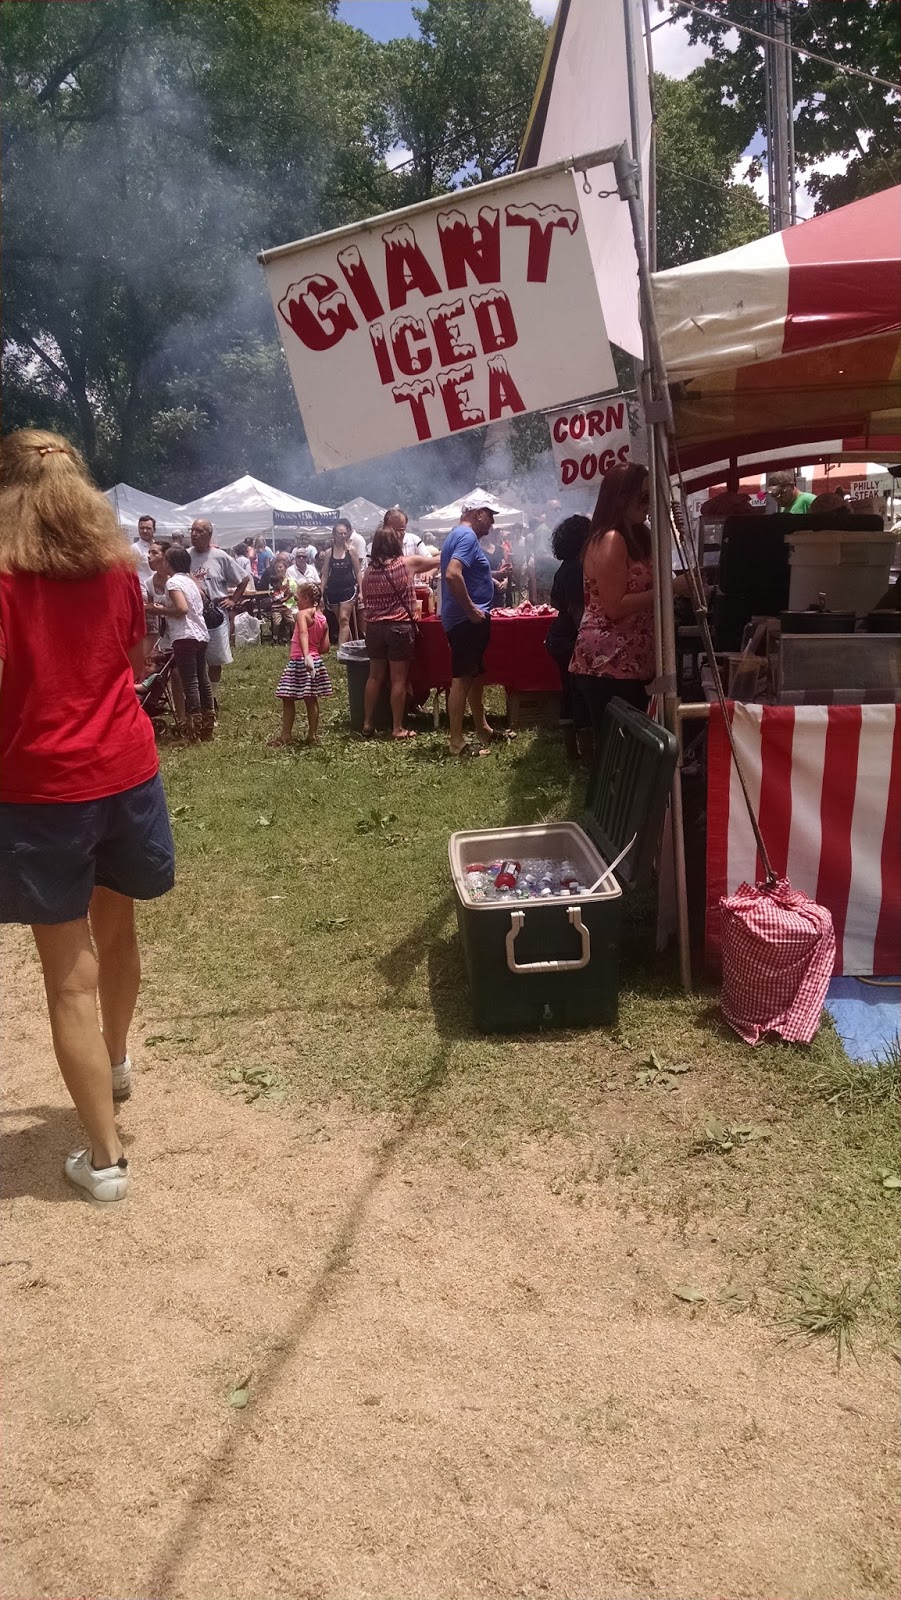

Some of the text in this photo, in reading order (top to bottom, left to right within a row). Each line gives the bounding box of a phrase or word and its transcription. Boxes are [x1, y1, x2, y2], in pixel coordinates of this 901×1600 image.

[277, 202, 579, 351] GIANT
[368, 287, 519, 385] ICED
[391, 353, 527, 441] TEA
[553, 402, 625, 444] CORN
[853, 480, 880, 491] PHILLY
[854, 490, 880, 500] STEAK
